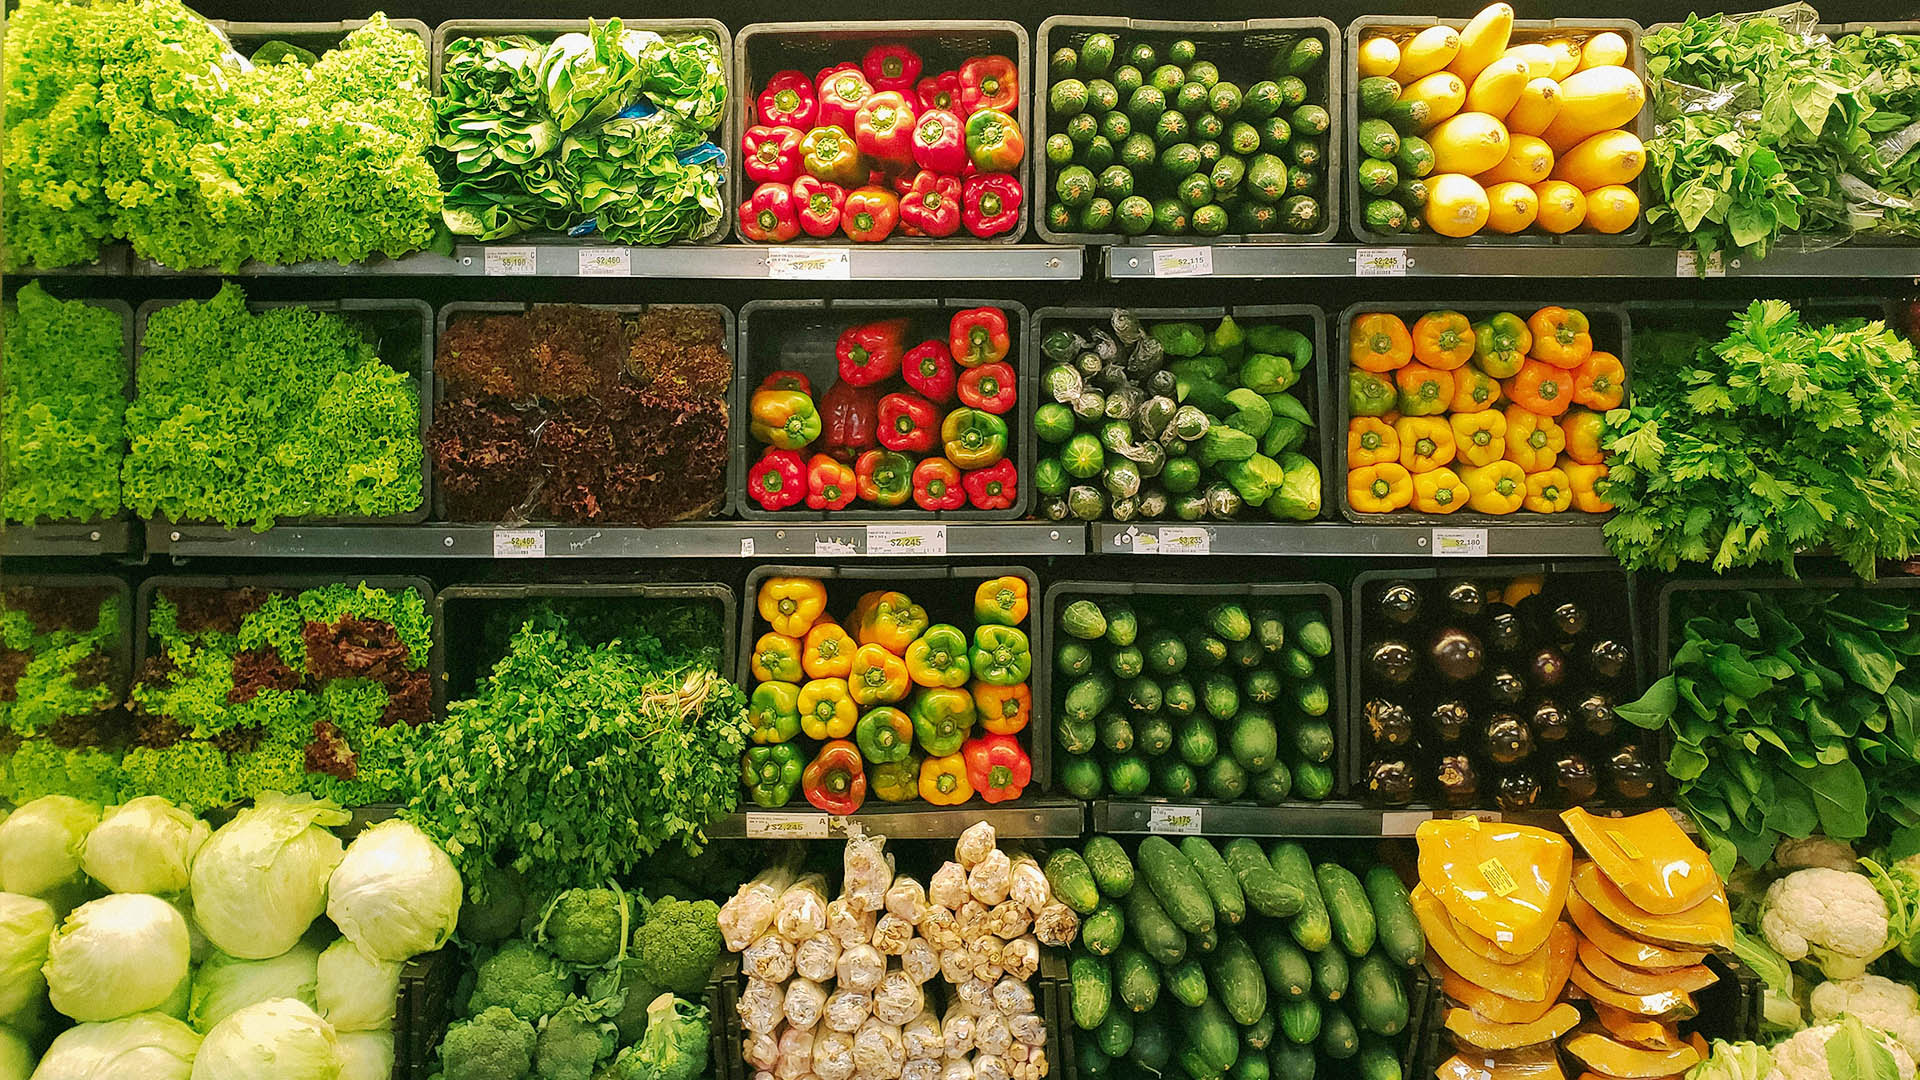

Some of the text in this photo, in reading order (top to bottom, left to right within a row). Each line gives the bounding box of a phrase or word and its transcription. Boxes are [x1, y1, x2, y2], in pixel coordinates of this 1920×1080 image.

[840, 254, 848, 263] A
[936, 530, 944, 538] A
[890, 538, 922, 547] $2,245
